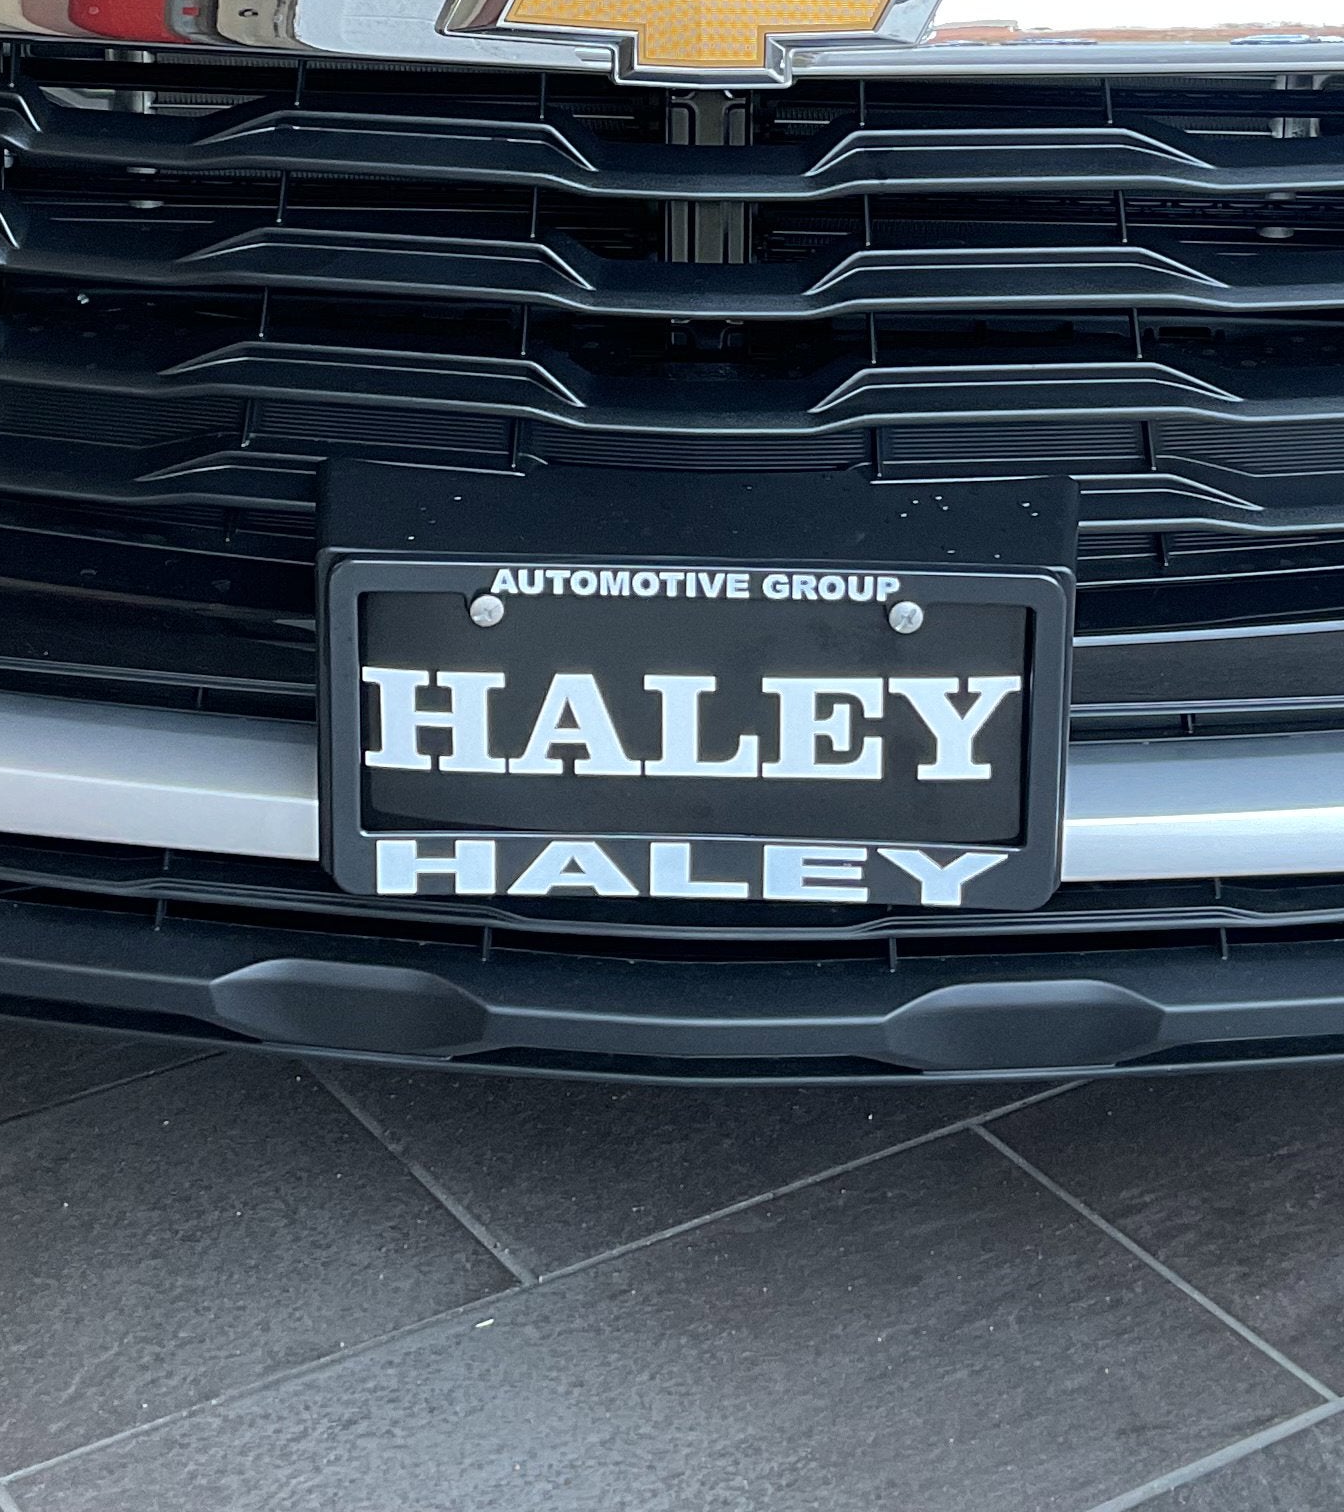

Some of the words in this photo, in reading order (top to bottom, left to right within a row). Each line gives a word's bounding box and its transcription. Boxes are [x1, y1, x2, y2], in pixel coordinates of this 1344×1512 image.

[489, 568, 750, 599] AUTOMOTIVE
[762, 574, 900, 602] GROUP
[361, 666, 1022, 781] HALEY
[375, 839, 1009, 907] HALEY
